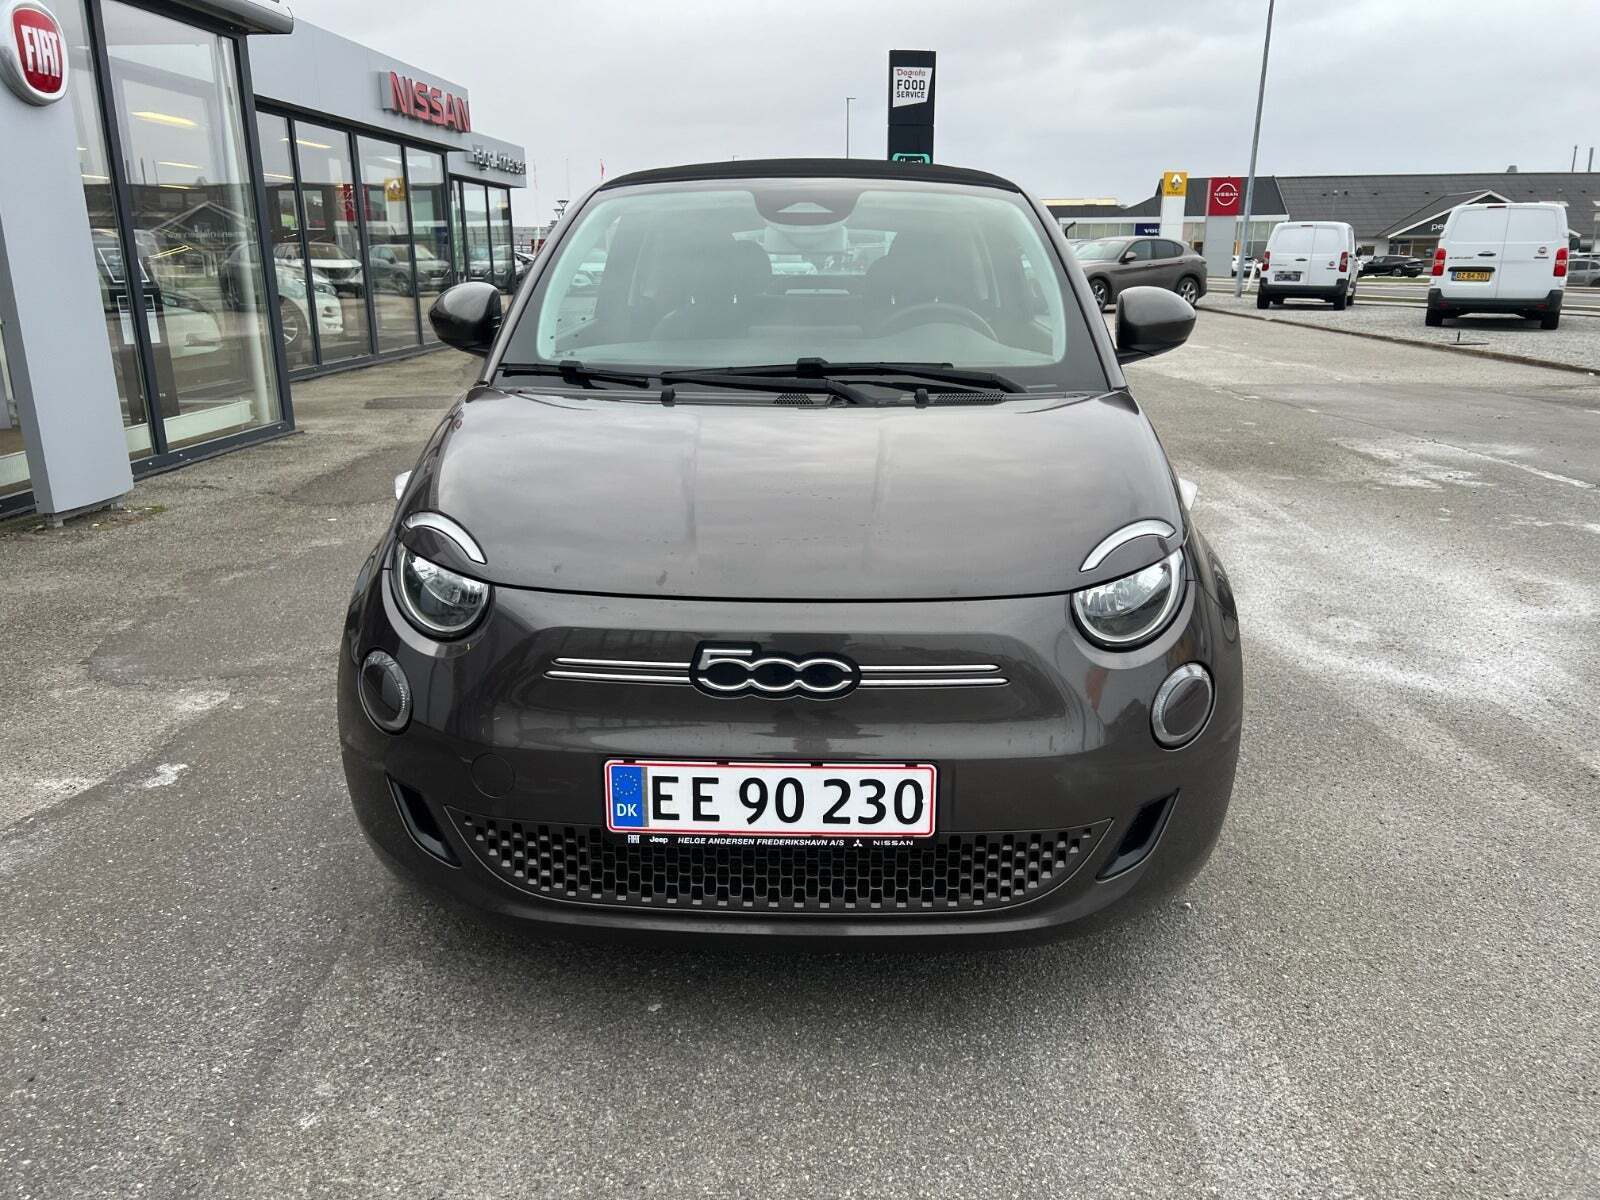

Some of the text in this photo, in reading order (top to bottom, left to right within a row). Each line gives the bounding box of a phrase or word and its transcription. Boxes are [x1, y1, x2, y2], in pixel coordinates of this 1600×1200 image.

[20, 24, 60, 78] FIAT
[896, 79, 926, 91] FOOD
[896, 91, 926, 99] SERVICE
[389, 71, 471, 133] NISSAN
[698, 649, 852, 692] 500
[616, 803, 638, 817] DK
[652, 775, 924, 825] EE 90 230
[649, 836, 669, 844] Jeep
[678, 836, 706, 844] HELGE
[708, 837, 755, 845] ANDERSEN
[757, 838, 828, 846] FREDERIKSHAVN
[829, 838, 845, 846] A/S
